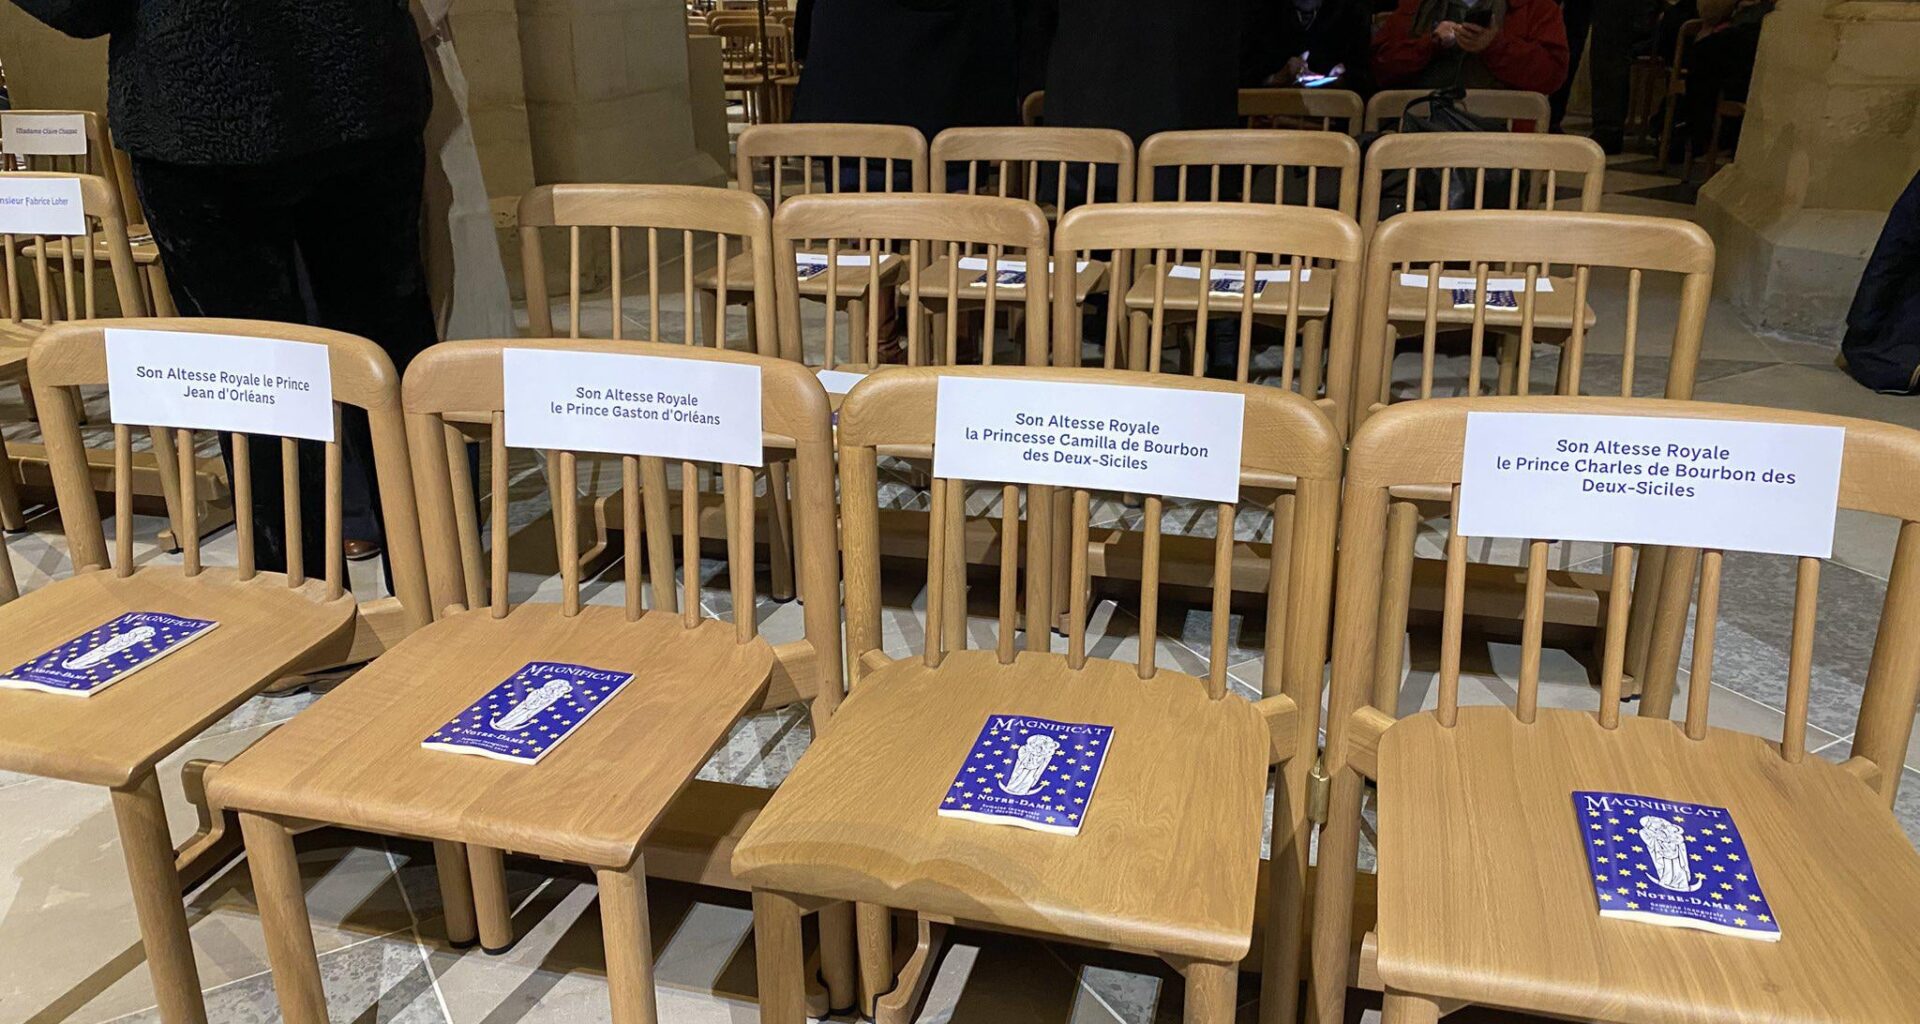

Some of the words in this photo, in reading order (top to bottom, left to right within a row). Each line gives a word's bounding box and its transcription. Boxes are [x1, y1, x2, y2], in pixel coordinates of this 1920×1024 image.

[26, 196, 50, 206] Fabrice
[137, 366, 163, 378] Son
[167, 368, 216, 382] Altesse
[220, 371, 260, 387] Royale
[263, 375, 273, 387] le
[276, 376, 310, 391] Prince
[184, 386, 214, 399] Jean
[218, 388, 275, 405] d'Orléans
[576, 387, 601, 400] Son
[605, 389, 653, 403] Altesse
[657, 392, 698, 408] Royale
[550, 401, 562, 414] le
[567, 403, 609, 416] Prince
[612, 406, 658, 420] Gaston
[662, 409, 720, 426] d'Orléans
[1015, 413, 1043, 426] Son
[1048, 415, 1104, 431] Altesse
[1109, 419, 1160, 435] Royale
[966, 427, 978, 440] la
[983, 428, 1055, 445] Princesse
[1060, 434, 1117, 450] Camilla
[1121, 438, 1139, 452] de
[1144, 440, 1208, 457] Bourbon
[1556, 439, 1588, 453] Son
[1594, 440, 1661, 457] Altesse
[1667, 444, 1730, 461] Royale
[1023, 448, 1049, 462] des
[1054, 452, 1148, 470] Deux-Siciles
[1497, 456, 1511, 470] le
[1516, 457, 1569, 472] Prince
[1575, 459, 1642, 475] Charles
[1648, 462, 1669, 476] de
[1676, 464, 1755, 481] Bourbon
[1762, 468, 1796, 484] des
[1582, 478, 1695, 498] Deux-Siciles
[122, 614, 208, 628] MAGNIFICAT
[523, 665, 624, 682] MAGNIFICAT
[462, 729, 525, 744] NOTRE-DAME
[991, 718, 1105, 735] MAGNIFICAT
[978, 794, 1051, 810] NOTRE-DAME
[1584, 795, 1721, 818] MAGNIFICAT
[1636, 890, 1732, 910] NOTRE-DAME
